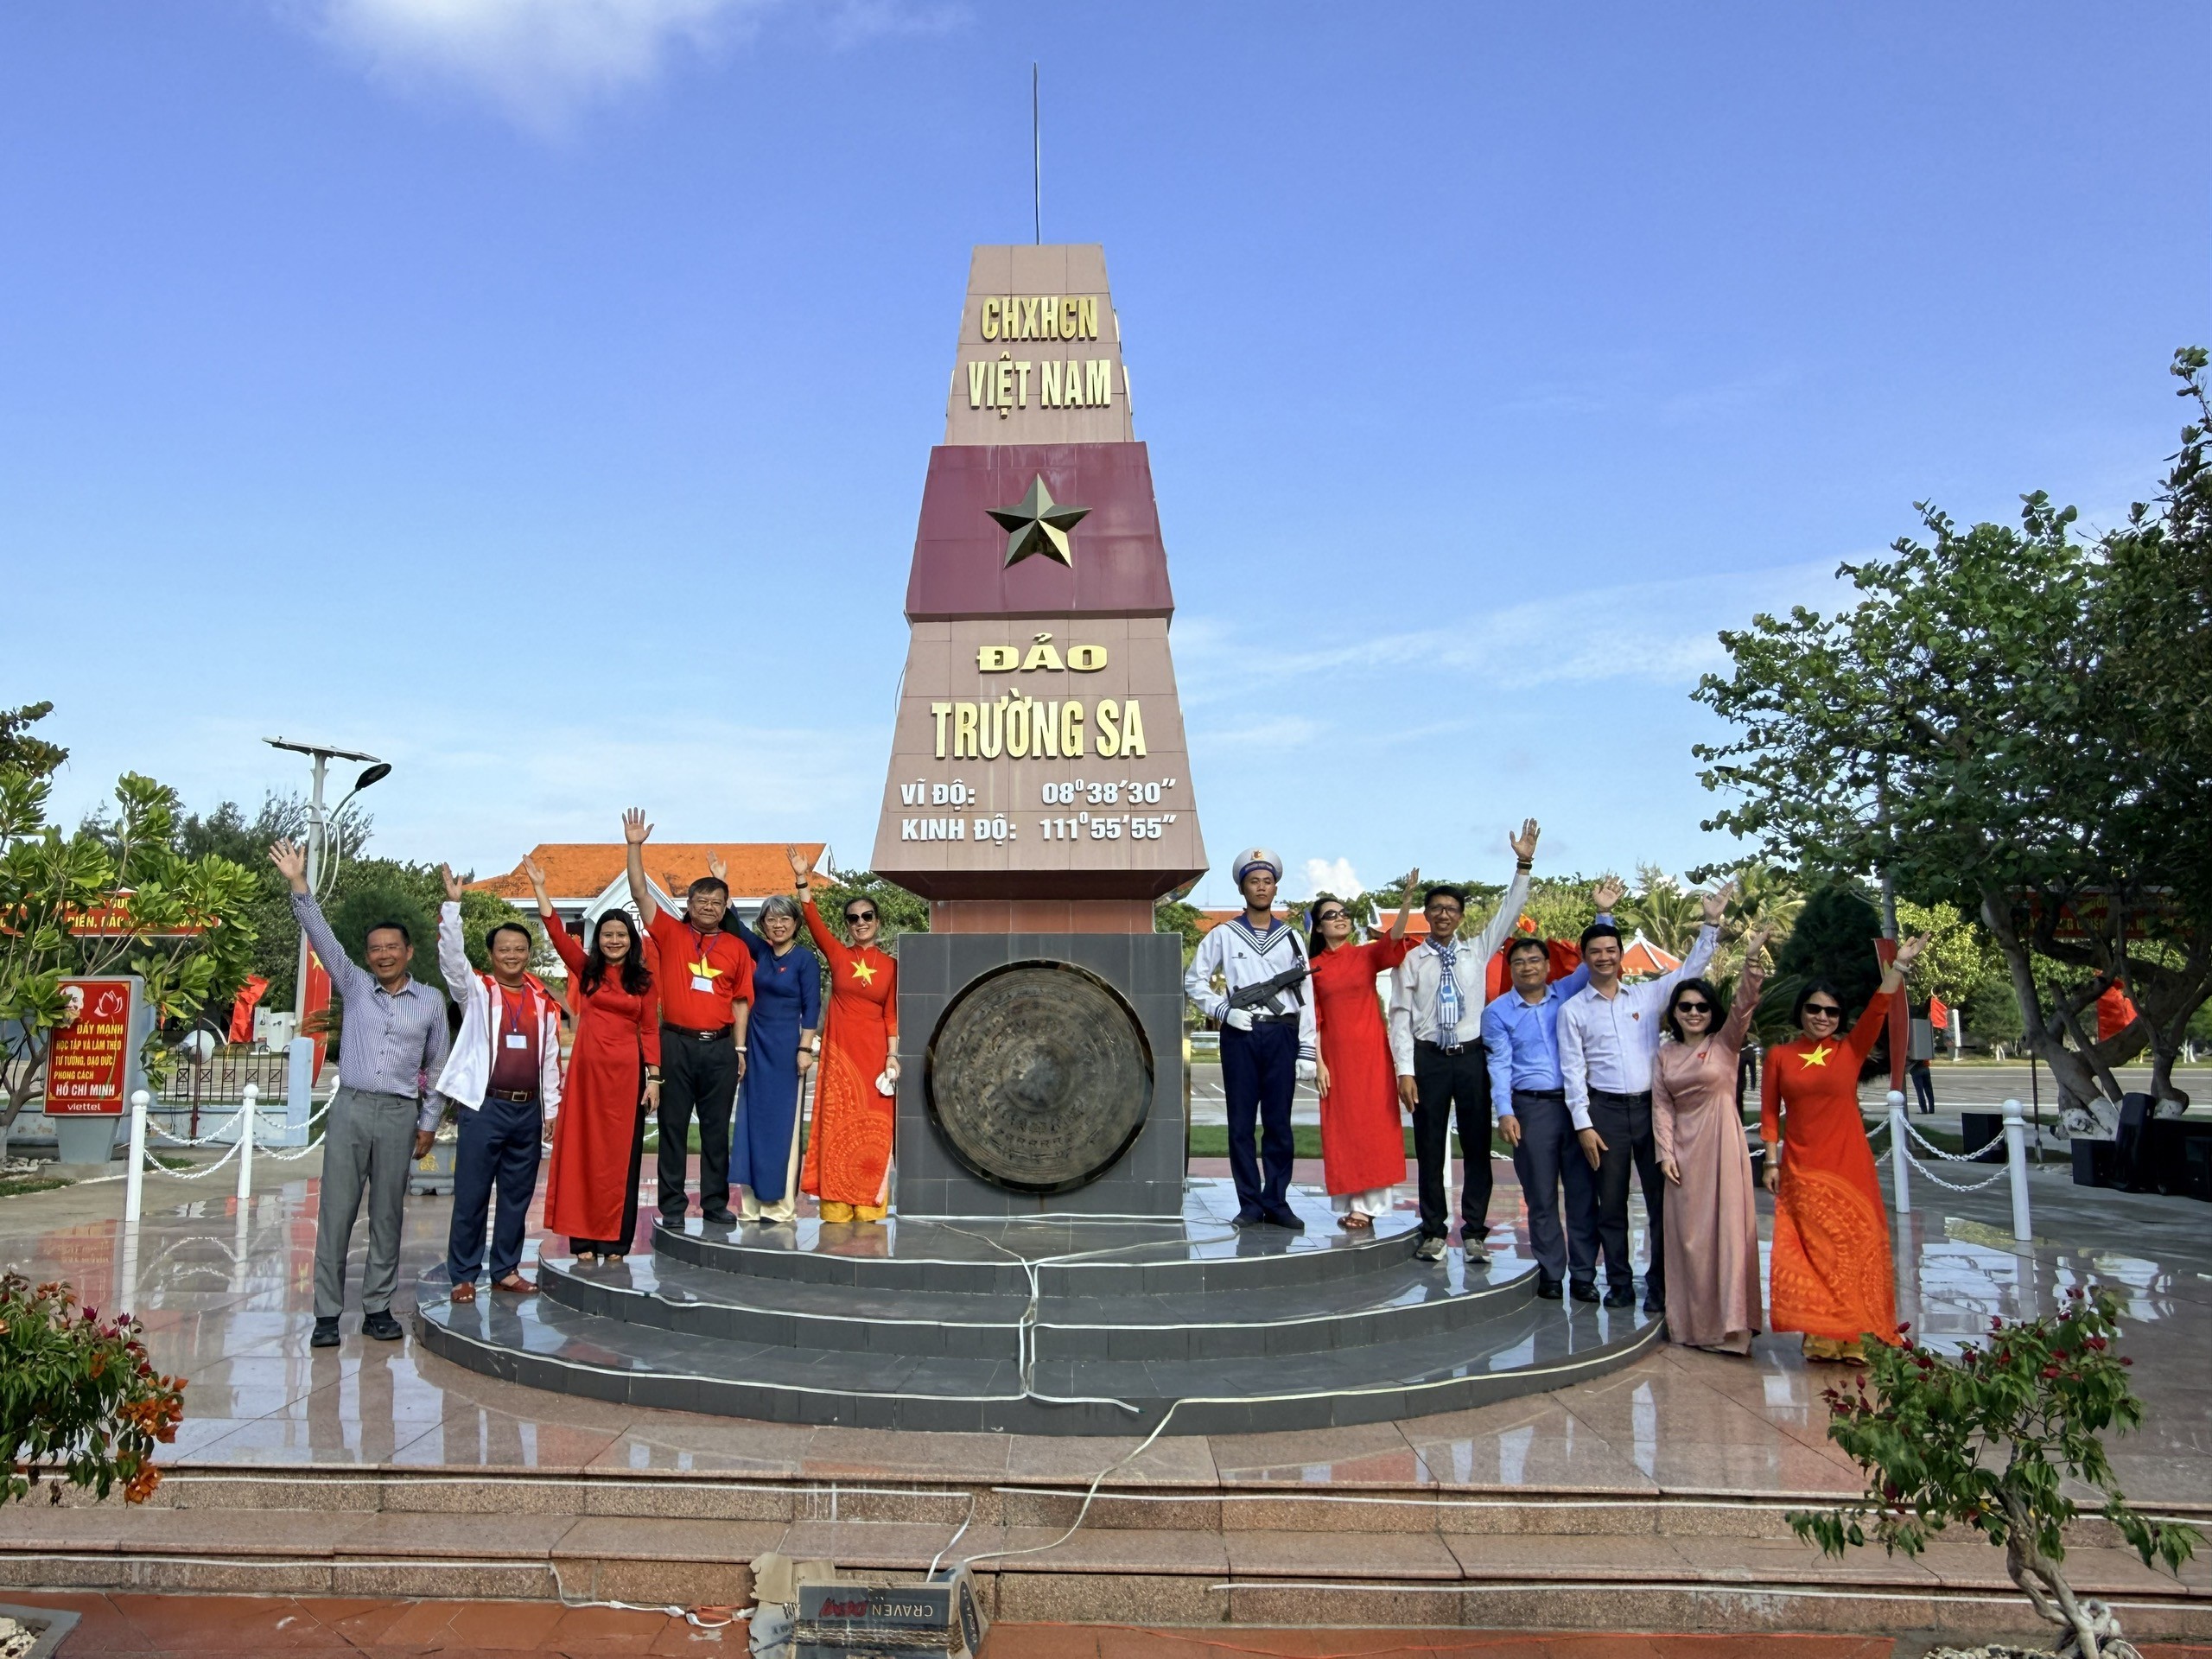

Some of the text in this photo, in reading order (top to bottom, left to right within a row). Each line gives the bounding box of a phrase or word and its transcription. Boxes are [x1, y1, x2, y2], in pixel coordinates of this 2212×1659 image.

[981, 296, 1097, 341] CHXHCN
[968, 350, 1111, 419] VIỆT NAM
[976, 632, 1108, 672] ĐẢO
[931, 688, 1147, 760] TRƯỜNG SA
[900, 778, 926, 805] VĨ
[932, 779, 976, 810] ĐỘ:
[901, 818, 964, 841] KINH
[974, 813, 1017, 845] ĐỘ:
[97, 1024, 124, 1036] MẠNH
[54, 1071, 75, 1079] PHONG
[71, 1082, 87, 1096] CHÍ
[90, 1084, 115, 1096] MINH
[67, 1103, 101, 1111] viettel
[872, 1604, 933, 1618] CRAVEN
